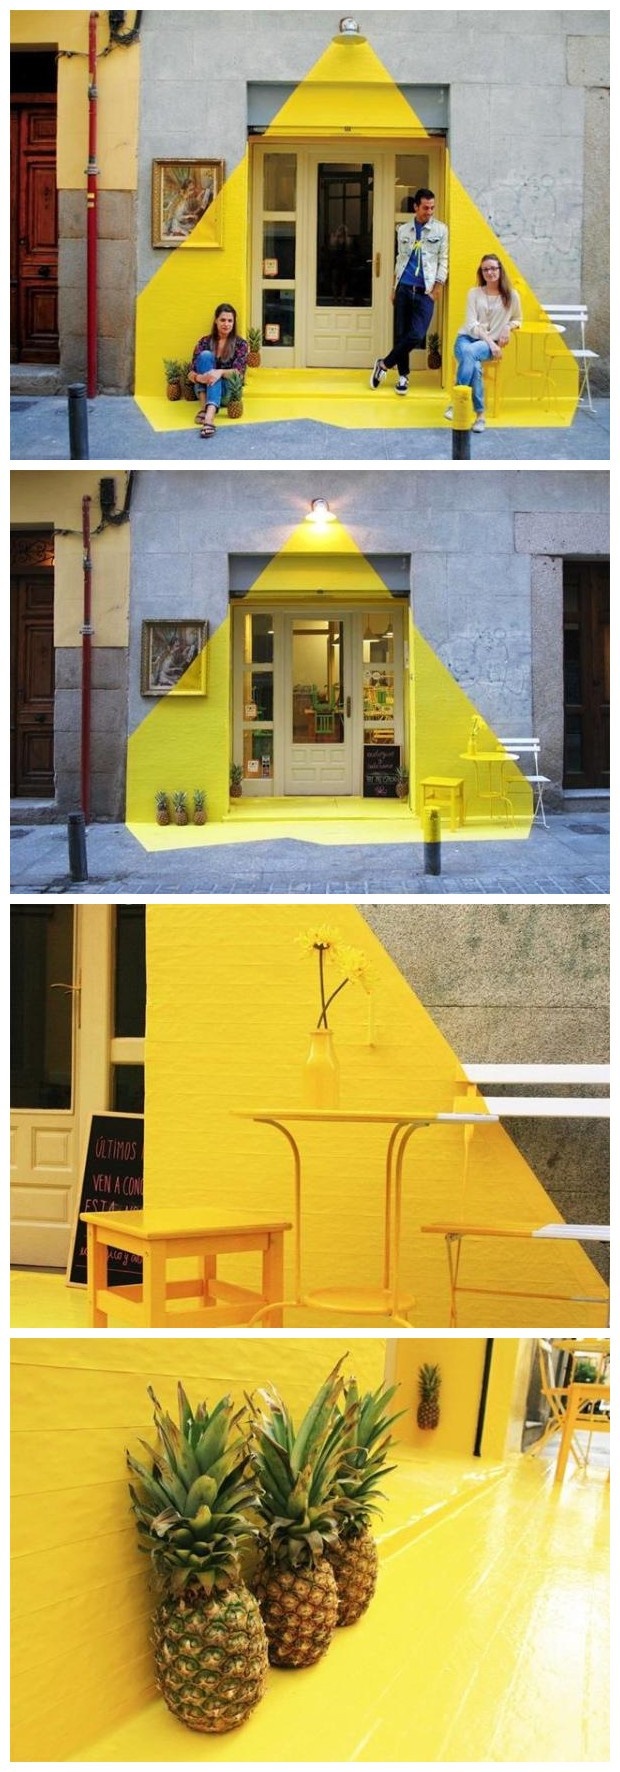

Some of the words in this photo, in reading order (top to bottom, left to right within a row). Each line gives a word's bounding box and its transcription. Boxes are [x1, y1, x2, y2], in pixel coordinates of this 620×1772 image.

[95, 1136, 137, 1161] ÚLTIMOS
[92, 1174, 112, 1193] VEN
[114, 1176, 121, 1195] A
